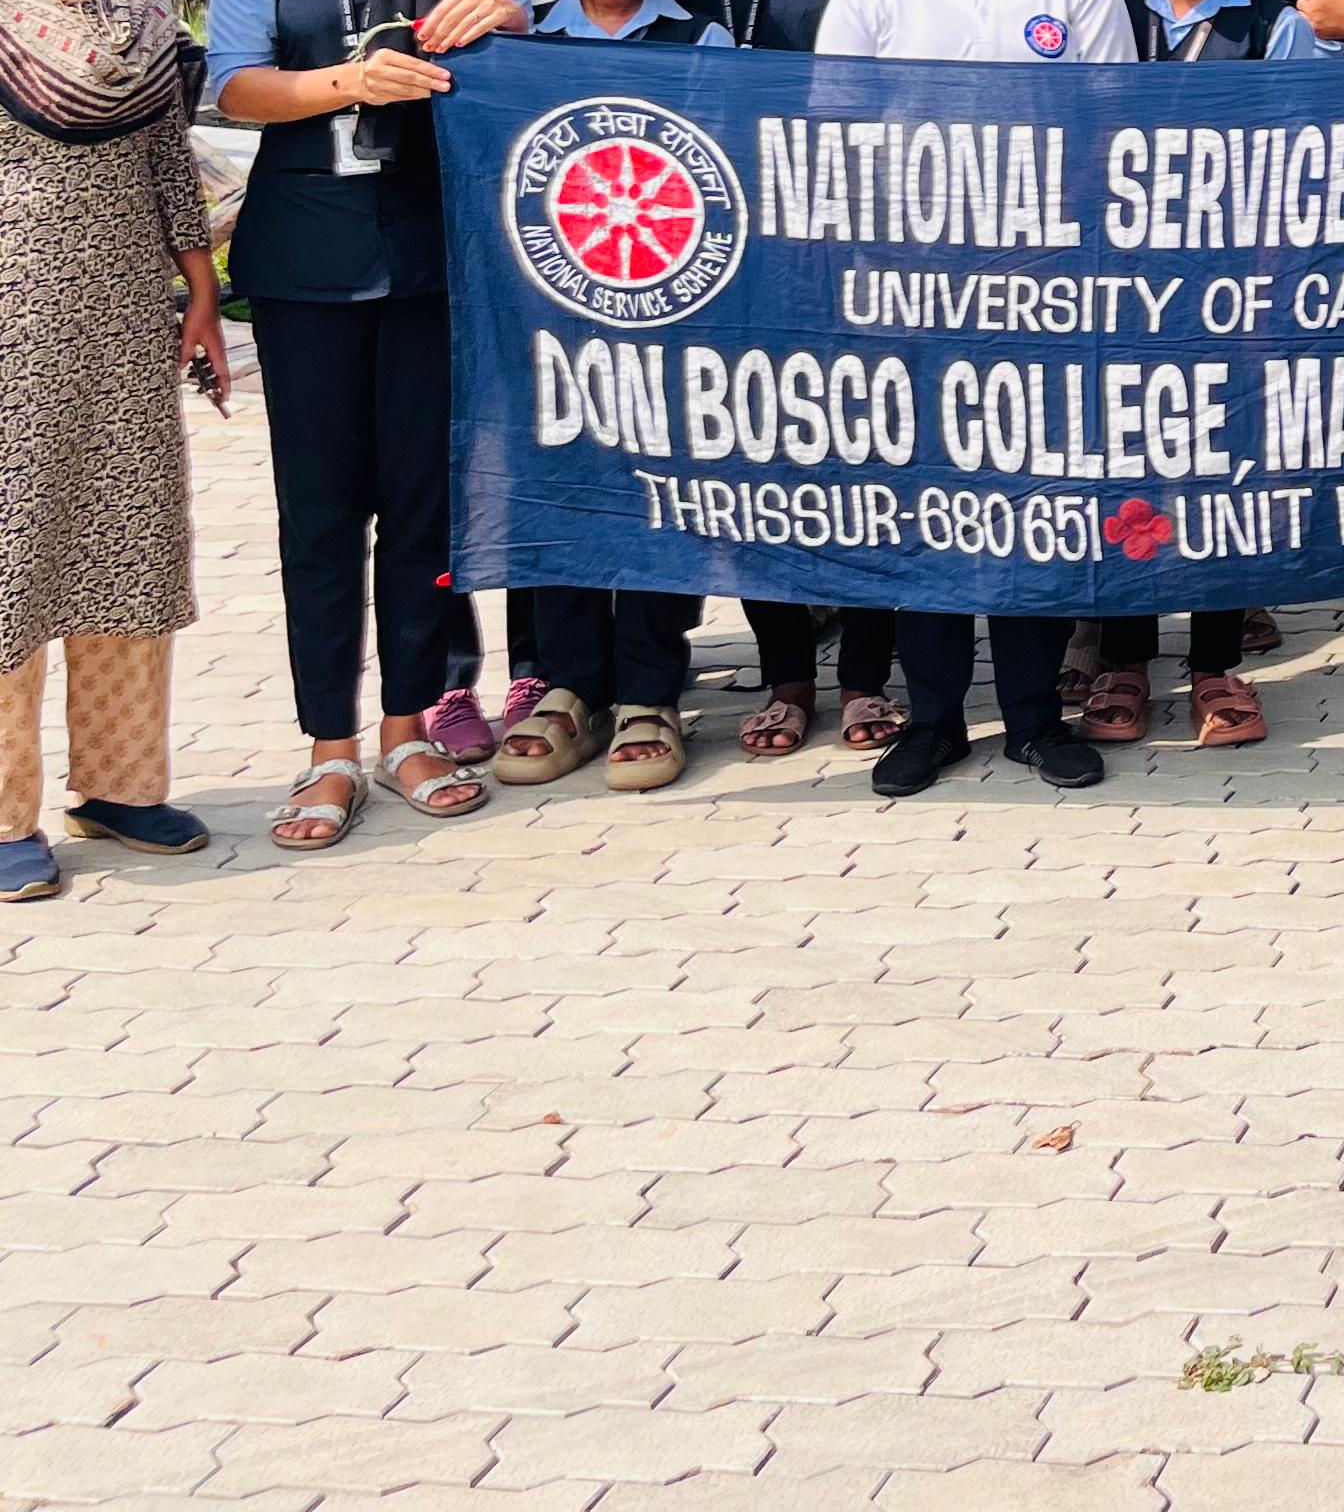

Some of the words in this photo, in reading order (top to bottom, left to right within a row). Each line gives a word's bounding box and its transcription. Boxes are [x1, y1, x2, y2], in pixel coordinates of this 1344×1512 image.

[584, 104, 656, 138] सेवा
[659, 121, 732, 210] योजना
[759, 116, 1081, 249] NATIONAL
[520, 225, 592, 303] NATIONAL
[592, 286, 673, 319] SERVICE
[671, 231, 733, 304] SCHEME
[843, 269, 1183, 334] UNIVERSITY
[1202, 275, 1273, 333] OF
[534, 329, 672, 458] DON
[683, 345, 917, 467] BOSCO
[940, 359, 1257, 486] COLLEGE,
[1176, 486, 1313, 561] UNIT
